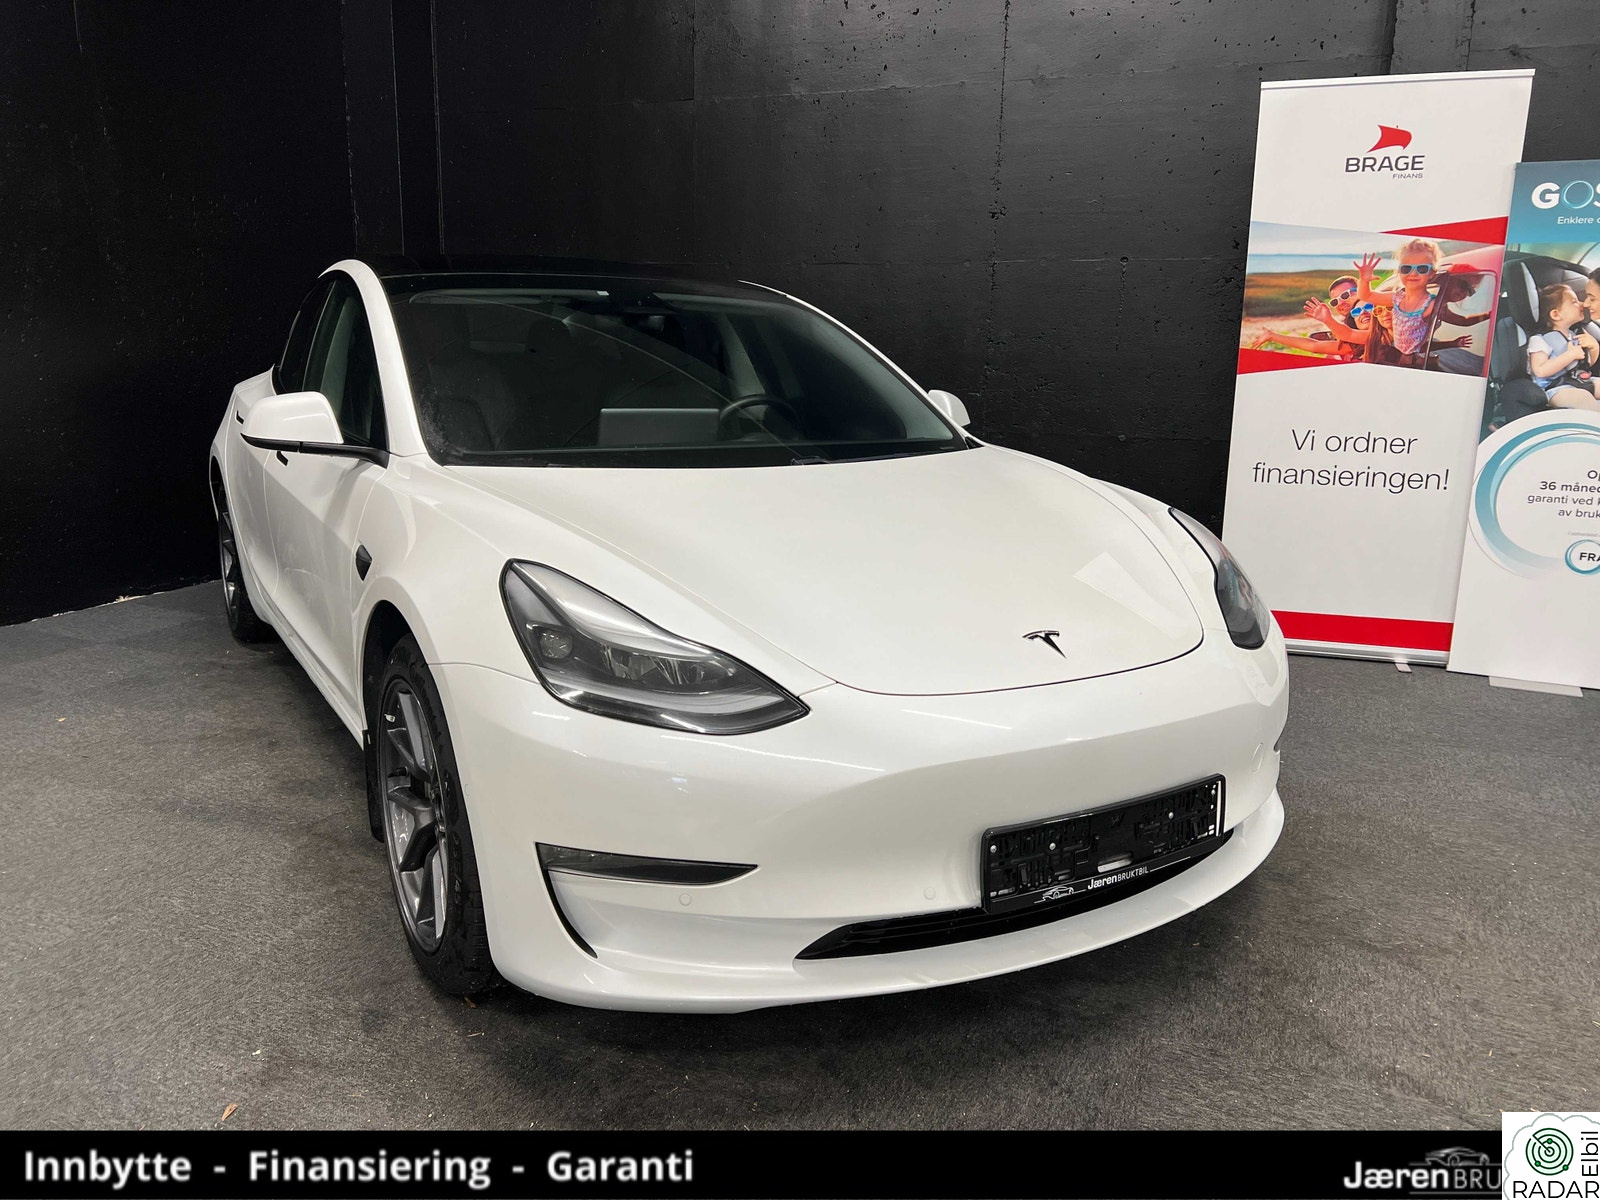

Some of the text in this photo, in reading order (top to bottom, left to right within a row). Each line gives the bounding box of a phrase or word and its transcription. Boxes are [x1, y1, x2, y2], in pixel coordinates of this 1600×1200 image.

[1345, 155, 1425, 172] BRAGE
[1557, 216, 1594, 225] Enklere
[1291, 429, 1418, 454] Vi ordner
[1252, 461, 1450, 495] finansieringen!
[1540, 481, 1557, 491] 36
[1527, 495, 1569, 504] garanti
[1572, 497, 1594, 506] ved
[1558, 509, 1573, 517] av
